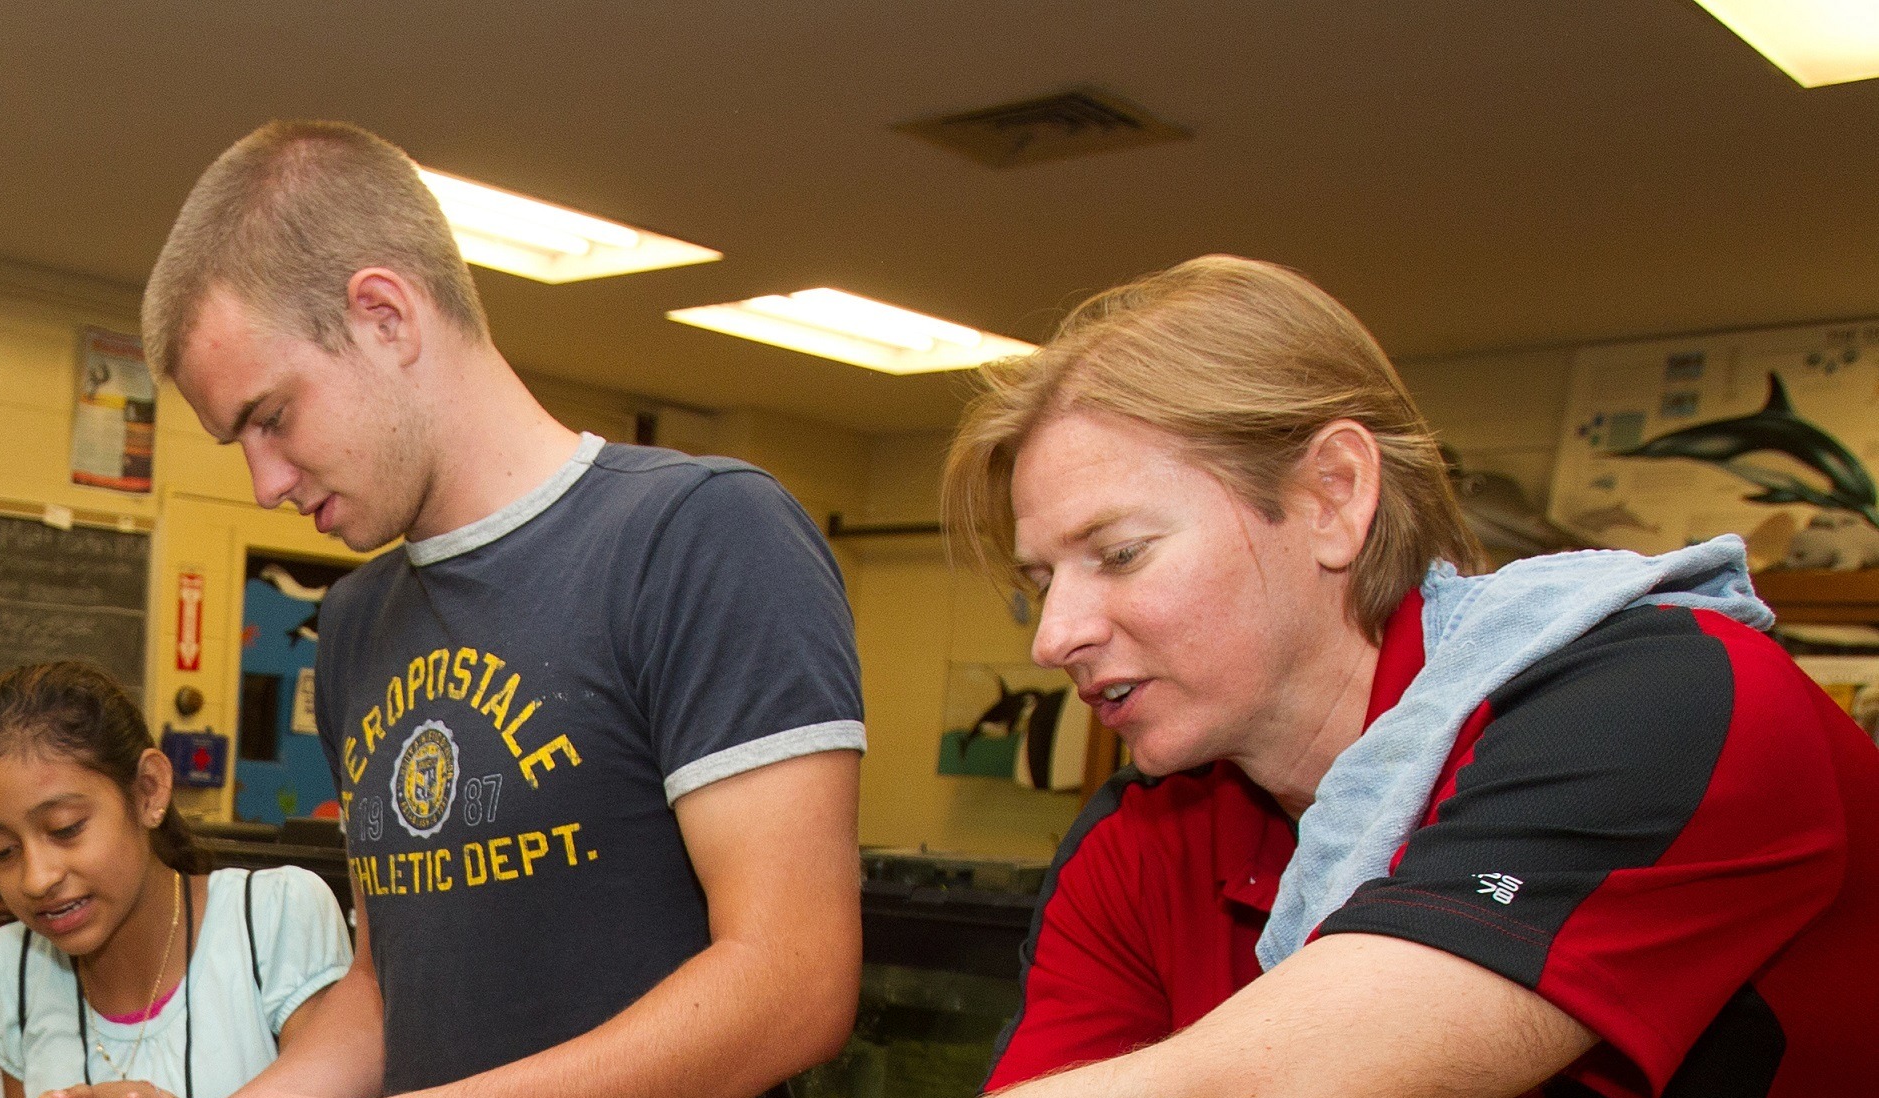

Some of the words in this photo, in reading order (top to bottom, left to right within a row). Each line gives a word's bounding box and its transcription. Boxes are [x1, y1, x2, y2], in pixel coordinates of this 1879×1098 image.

[358, 795, 384, 842] 19
[463, 773, 503, 827] 87
[462, 822, 600, 887] DEPT.
